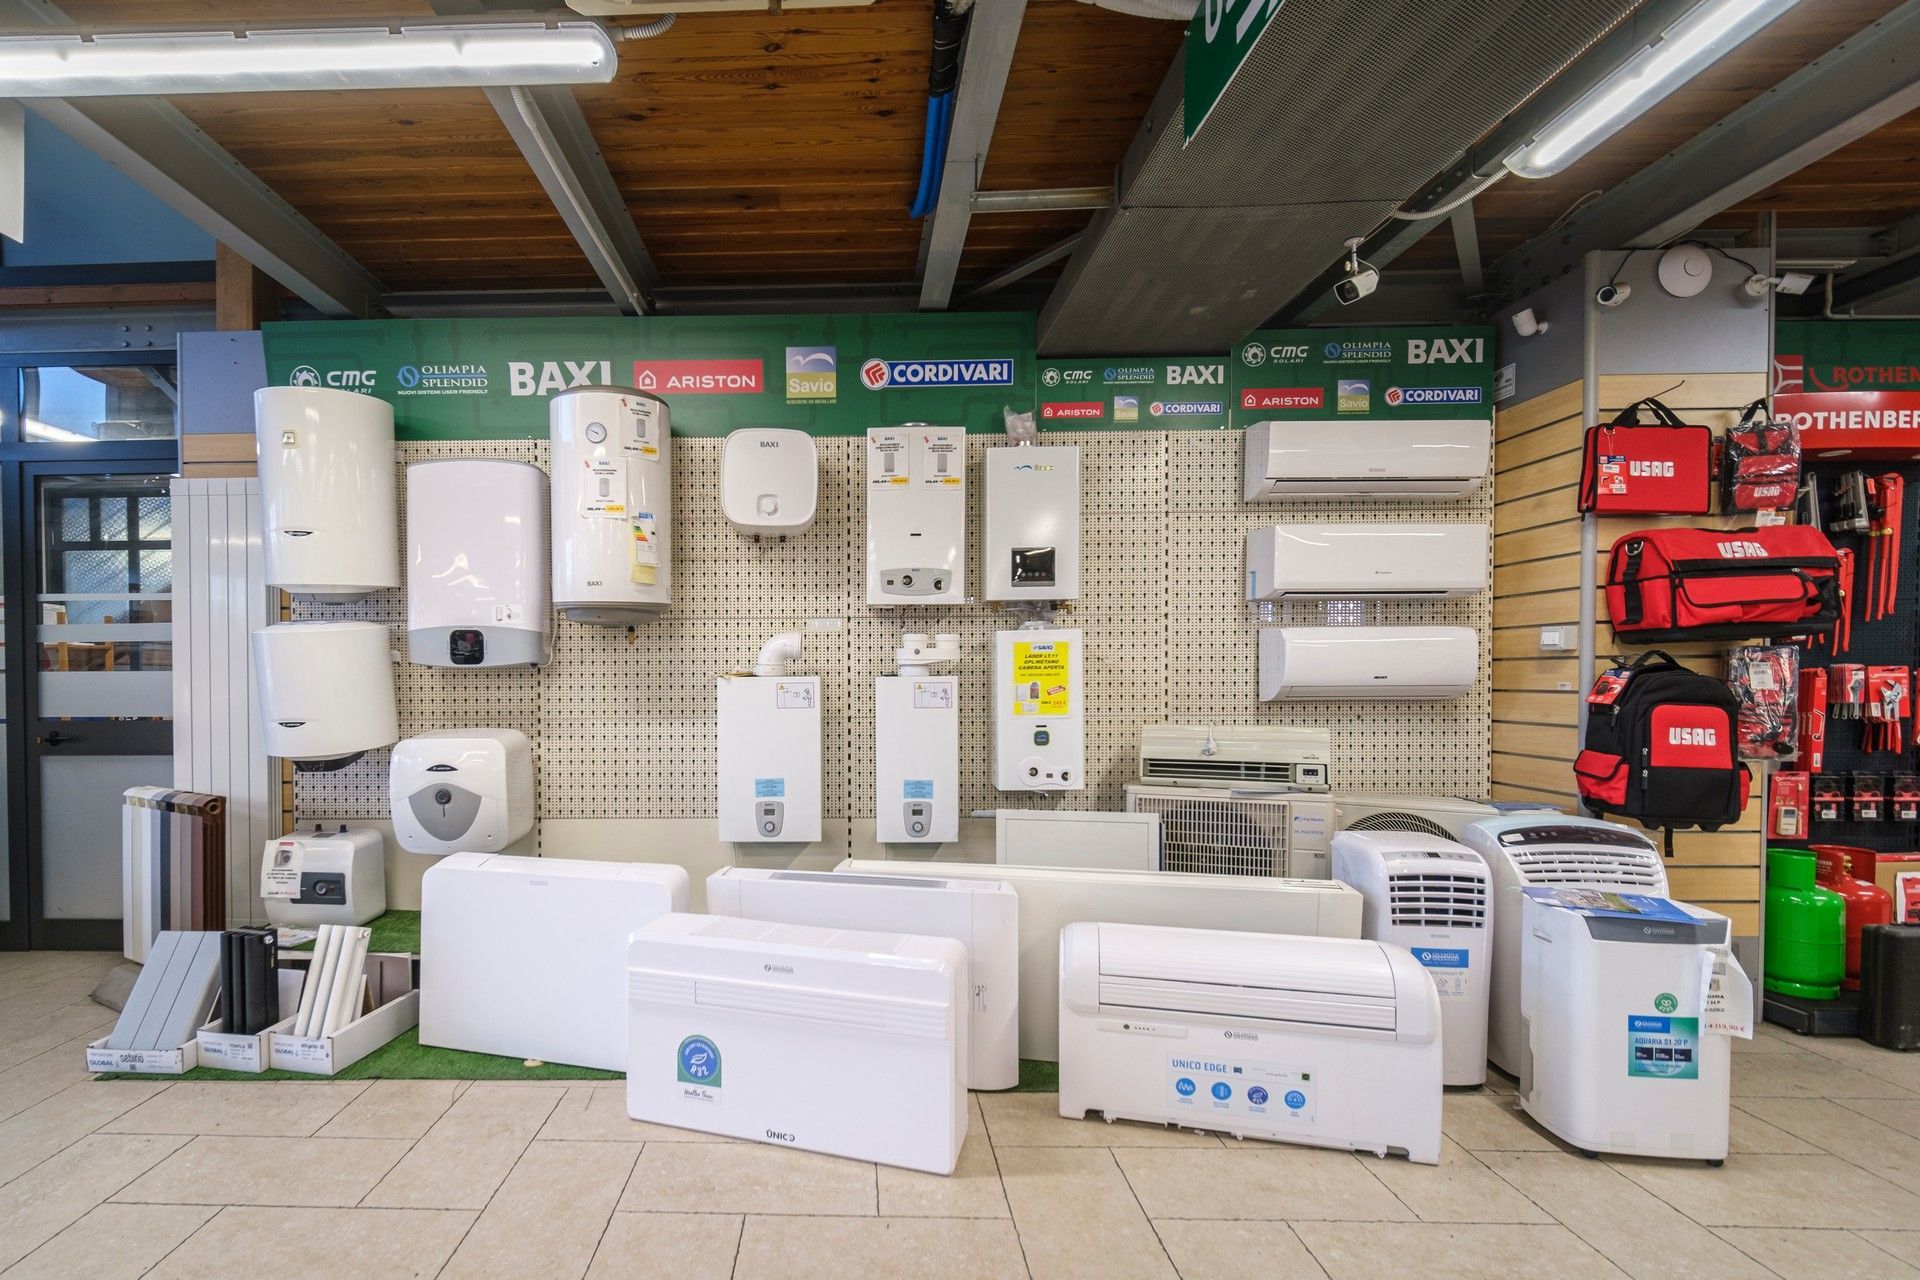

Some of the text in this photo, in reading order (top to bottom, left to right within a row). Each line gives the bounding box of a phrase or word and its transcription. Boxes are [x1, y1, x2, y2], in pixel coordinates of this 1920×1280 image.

[1270, 346, 1309, 358] CMG
[1408, 338, 1484, 364] BAXI
[421, 365, 487, 374] OLIMPIA
[893, 363, 1008, 383] CORDIVARI
[1063, 370, 1093, 380] CMG
[1166, 365, 1224, 385] BAXI
[326, 370, 377, 386] CMG
[422, 378, 488, 388] SPLENDID
[508, 360, 611, 396] BAXI
[667, 374, 756, 388] ARISTON
[789, 378, 834, 393] Savio
[1262, 396, 1319, 406] ARISTON
[1405, 389, 1479, 401] CORDIVARI
[1165, 404, 1220, 414] CORDIVARI
[1339, 398, 1369, 408] Savio
[1057, 408, 1100, 416] ARISTON
[1630, 461, 1674, 477] USAG
[1754, 486, 1780, 497] USAG
[1717, 541, 1769, 558] USAG
[1668, 727, 1716, 746] USAG
[1634, 1037, 1663, 1045] AQUARIA
[1172, 1058, 1229, 1074] UNICO EDGE
